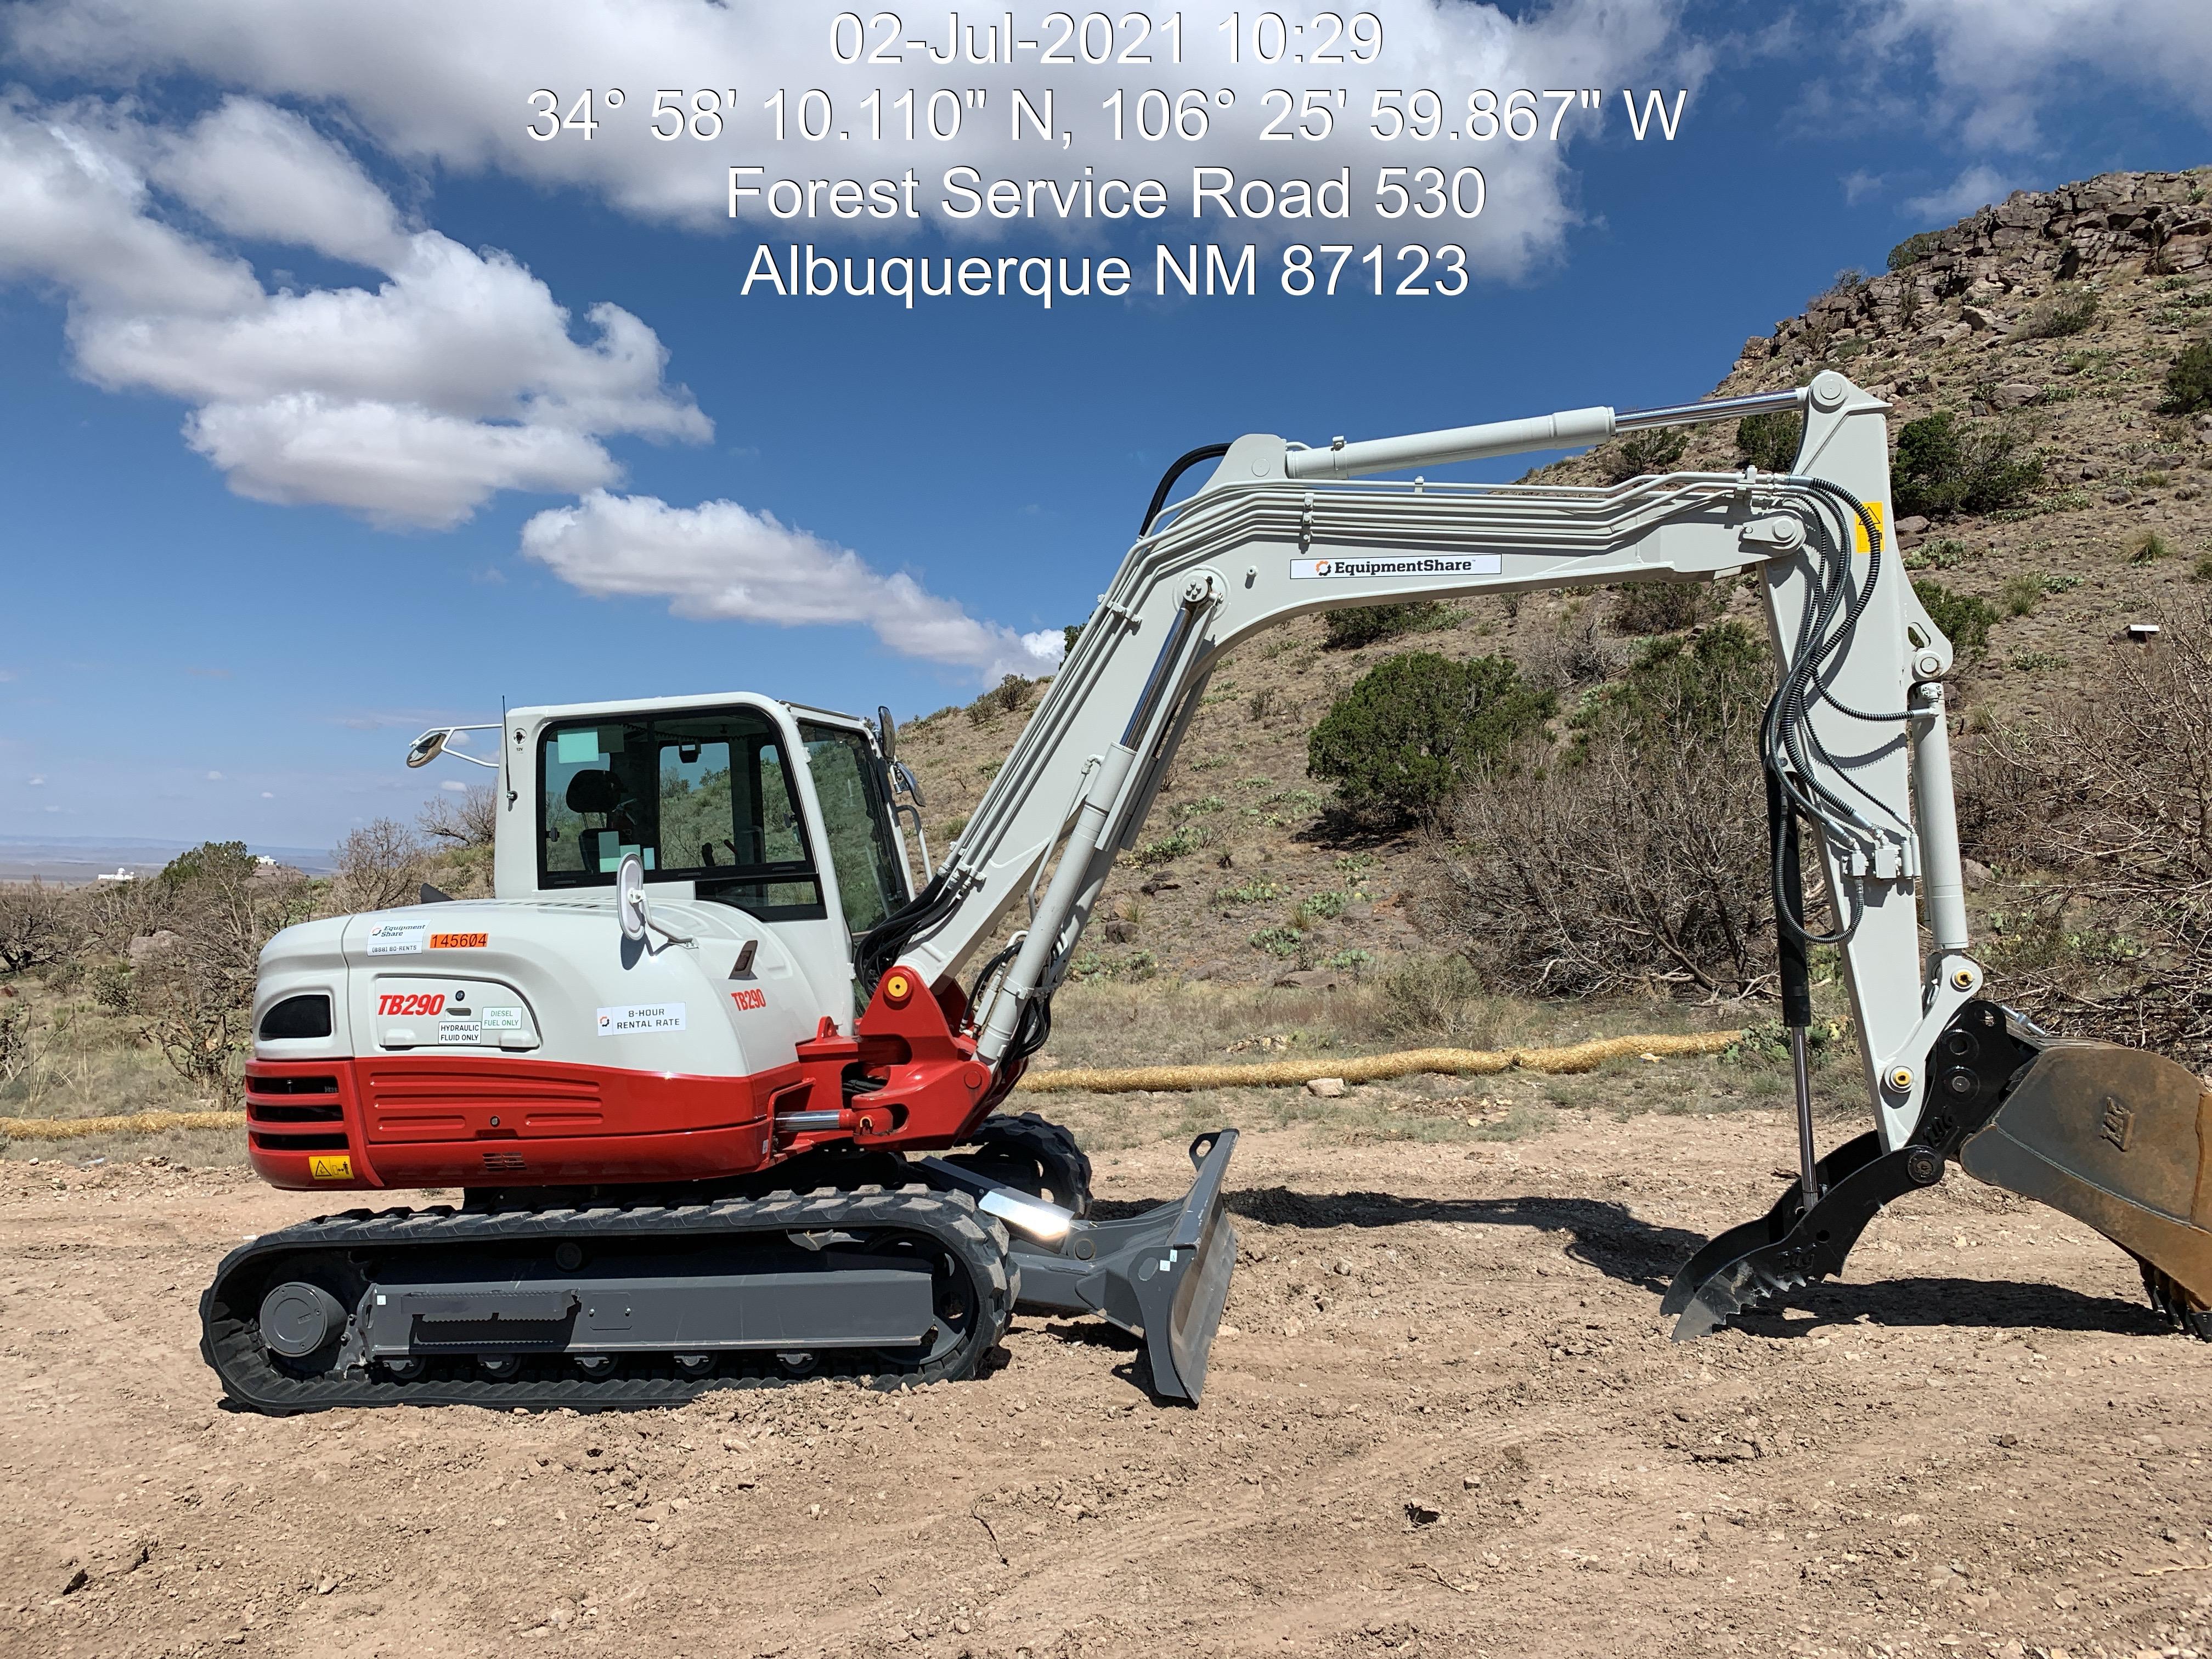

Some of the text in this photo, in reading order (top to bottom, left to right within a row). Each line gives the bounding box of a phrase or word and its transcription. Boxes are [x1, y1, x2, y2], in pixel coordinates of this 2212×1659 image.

[384, 924, 426, 932] Equipment
[432, 933, 487, 948] 145604
[378, 994, 446, 1016] TB290
[730, 988, 767, 1012] TB290
[628, 1008, 665, 1018] 8-HOUR
[617, 1018, 680, 1030] RENTAL RATE
